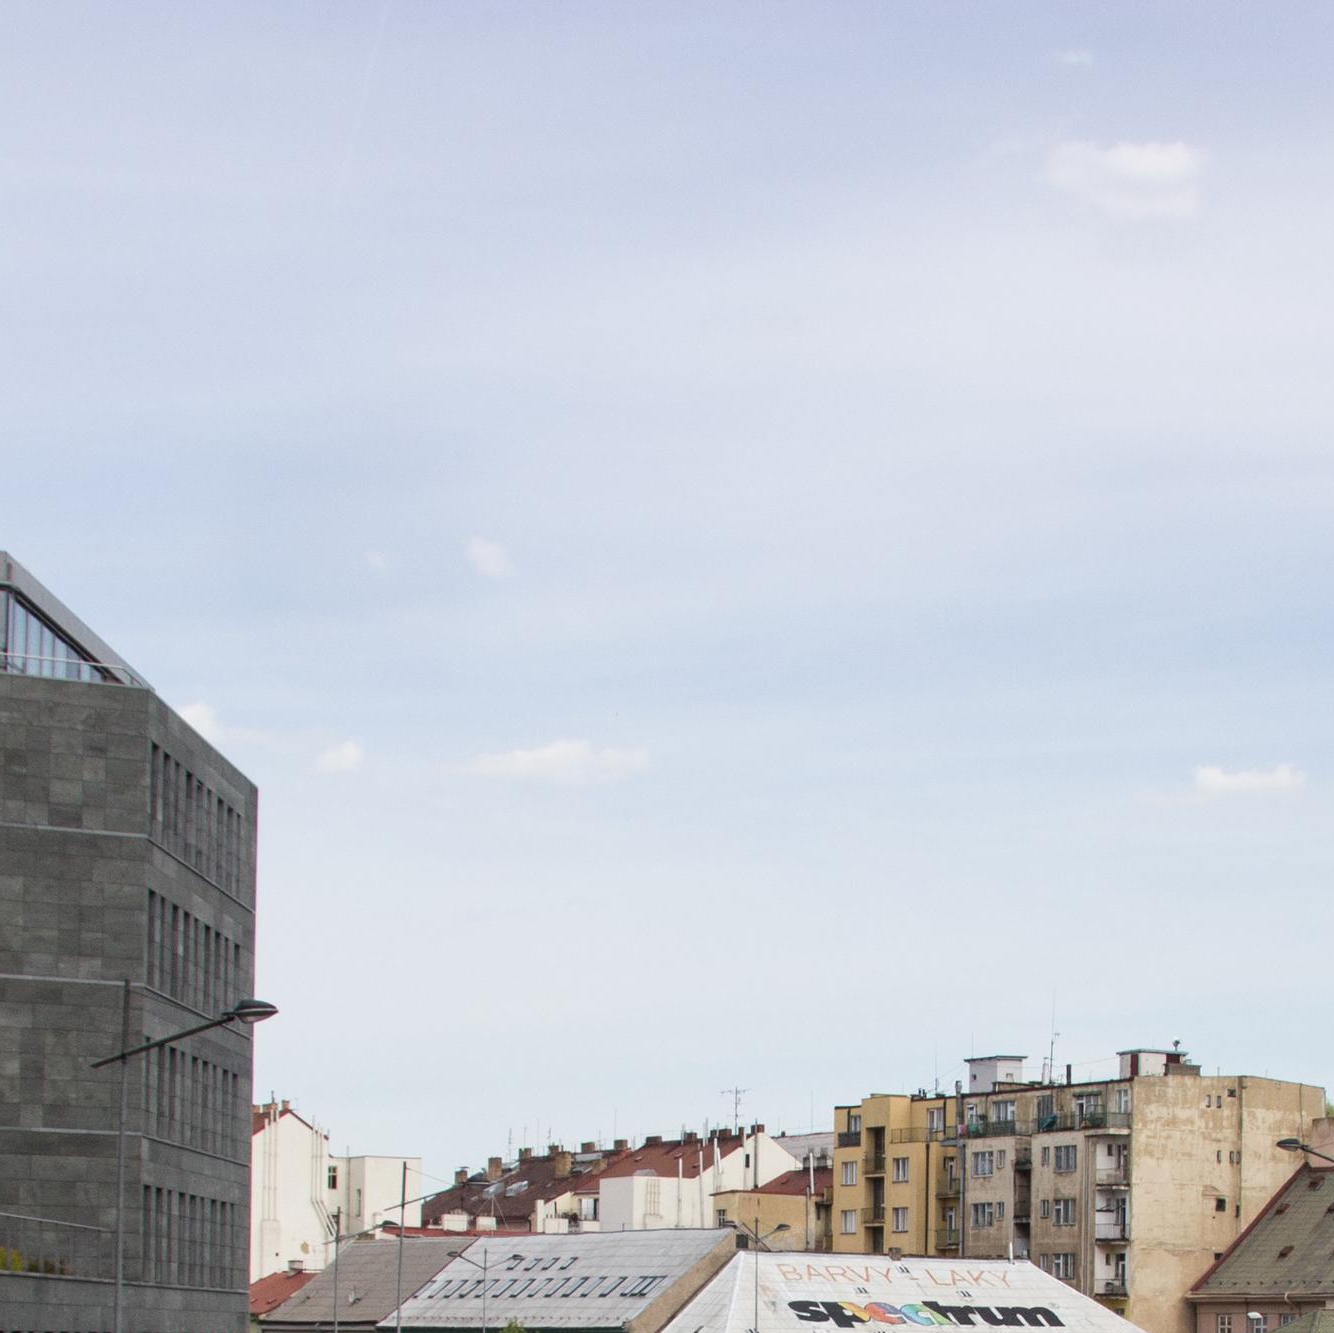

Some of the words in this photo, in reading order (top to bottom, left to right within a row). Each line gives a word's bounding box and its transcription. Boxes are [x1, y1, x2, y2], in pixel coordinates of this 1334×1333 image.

[777, 1263, 893, 1283] BARVY
[925, 1269, 1012, 1288] LAKY
[787, 1300, 1066, 1328] spectrum
